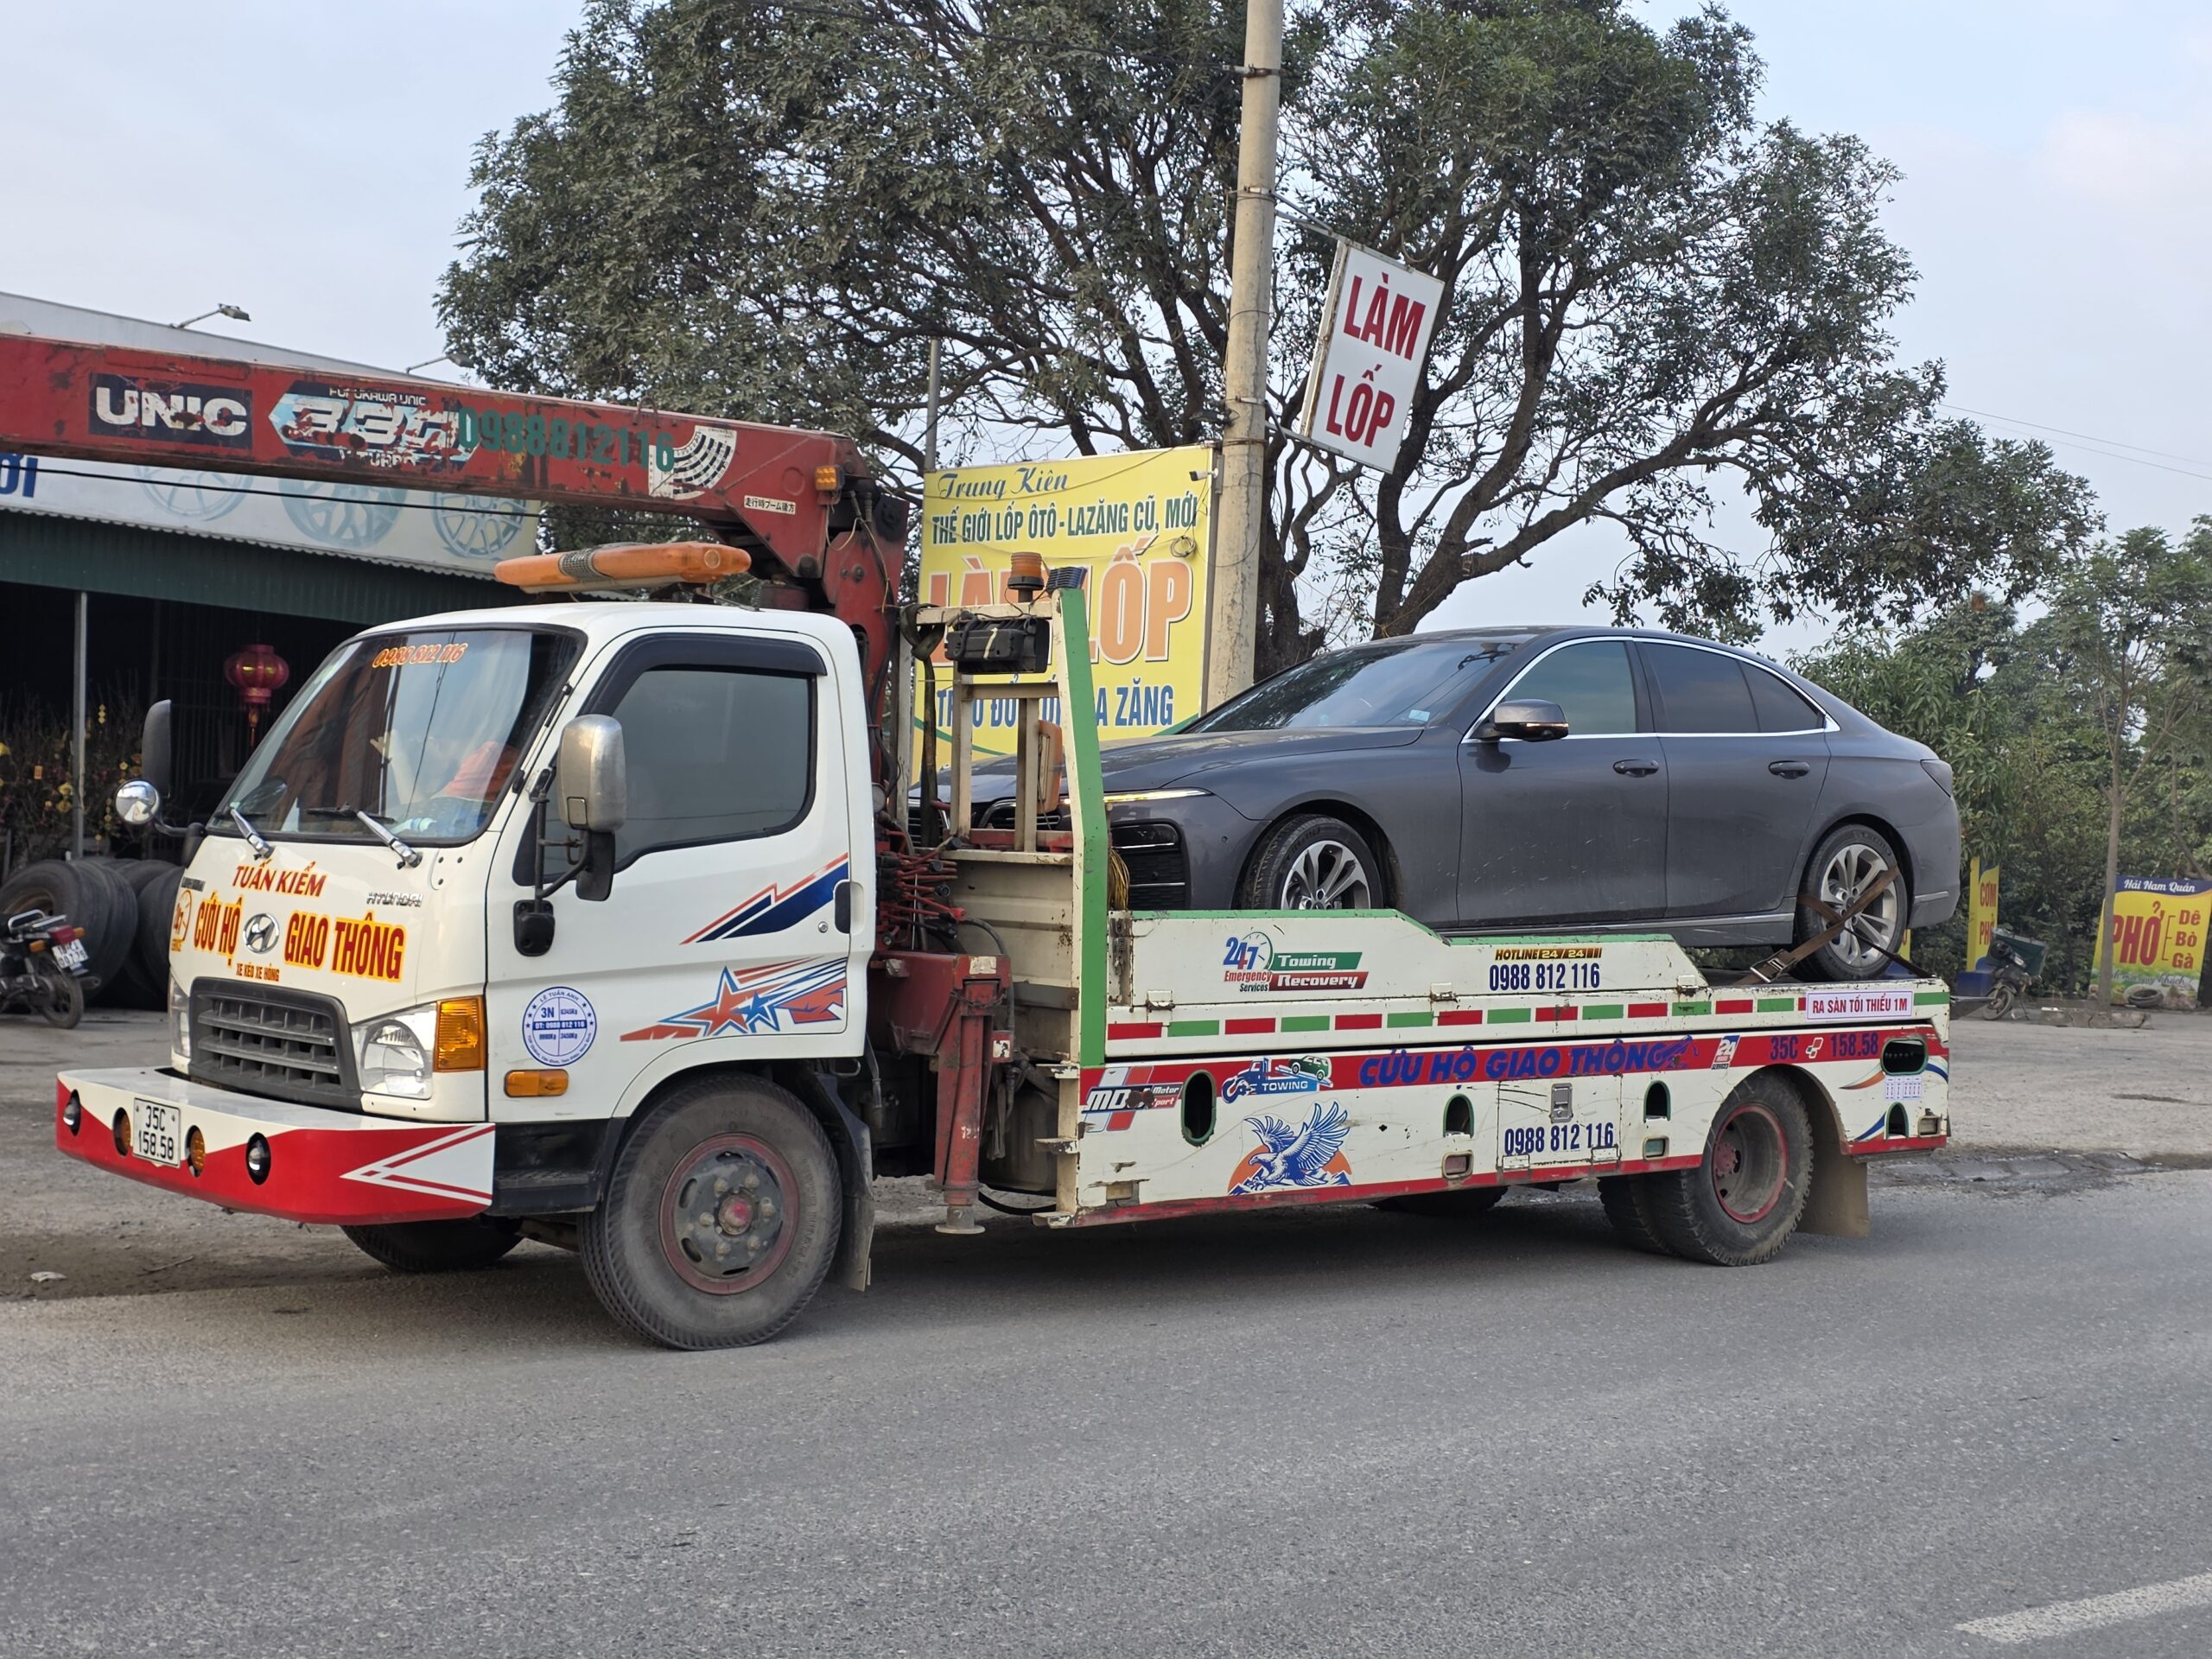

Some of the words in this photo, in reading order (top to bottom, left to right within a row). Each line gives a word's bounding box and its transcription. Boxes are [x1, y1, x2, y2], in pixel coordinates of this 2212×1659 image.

[1344, 272, 1426, 361] LÀM
[96, 386, 247, 436] UNIC
[1326, 364, 1395, 448] LỐP
[458, 407, 675, 473] 0988812116
[938, 473, 1006, 499] Trung
[1009, 467, 1068, 493] Kiên
[932, 505, 959, 544] THẾ
[962, 506, 991, 543] GIỚI
[995, 500, 1023, 540] LỐP
[1028, 502, 1056, 539] ÔTÔ
[1068, 498, 1128, 536] LAZĂNG
[1166, 490, 1198, 529] MỚI
[1078, 536, 1193, 664] ỐP
[372, 646, 415, 668] 0988
[410, 644, 442, 664] 812
[1115, 678, 1173, 727] ZĂNG
[232, 859, 276, 892] TUẤN
[2143, 880, 2166, 891] Nam
[2178, 910, 2201, 925] Dê
[218, 897, 242, 966] HỘ
[284, 912, 329, 967] GIAO
[333, 912, 405, 980] THÔNG
[2175, 931, 2197, 947] Bò
[1278, 955, 1337, 969] Towing
[1495, 949, 1539, 961] HOTLINE
[2171, 953, 2194, 969] Gà
[1224, 970, 1272, 983] Emergency
[1277, 974, 1358, 988] Recovery
[1239, 982, 1268, 992] Services
[1490, 963, 1530, 991] 0988
[1535, 963, 1566, 989] 812
[1571, 962, 1600, 988] 116
[541, 1007, 554, 1018] 3N
[1812, 1000, 1825, 1014] RA
[1849, 994, 1863, 1013] TỐI
[1485, 1048, 1561, 1079] GIAO
[1568, 1038, 1665, 1076] THÔNG
[1770, 1036, 1799, 1060] 35C
[1830, 1031, 1879, 1057] 158.58
[1152, 1086, 1179, 1095] Motor
[1262, 1080, 1308, 1091] TOWING
[145, 1105, 166, 1132] 35C
[138, 1129, 175, 1160] 158.58
[1504, 1126, 1544, 1155] 0988
[1550, 1124, 1580, 1153] 812
[1586, 1122, 1614, 1149] 116
